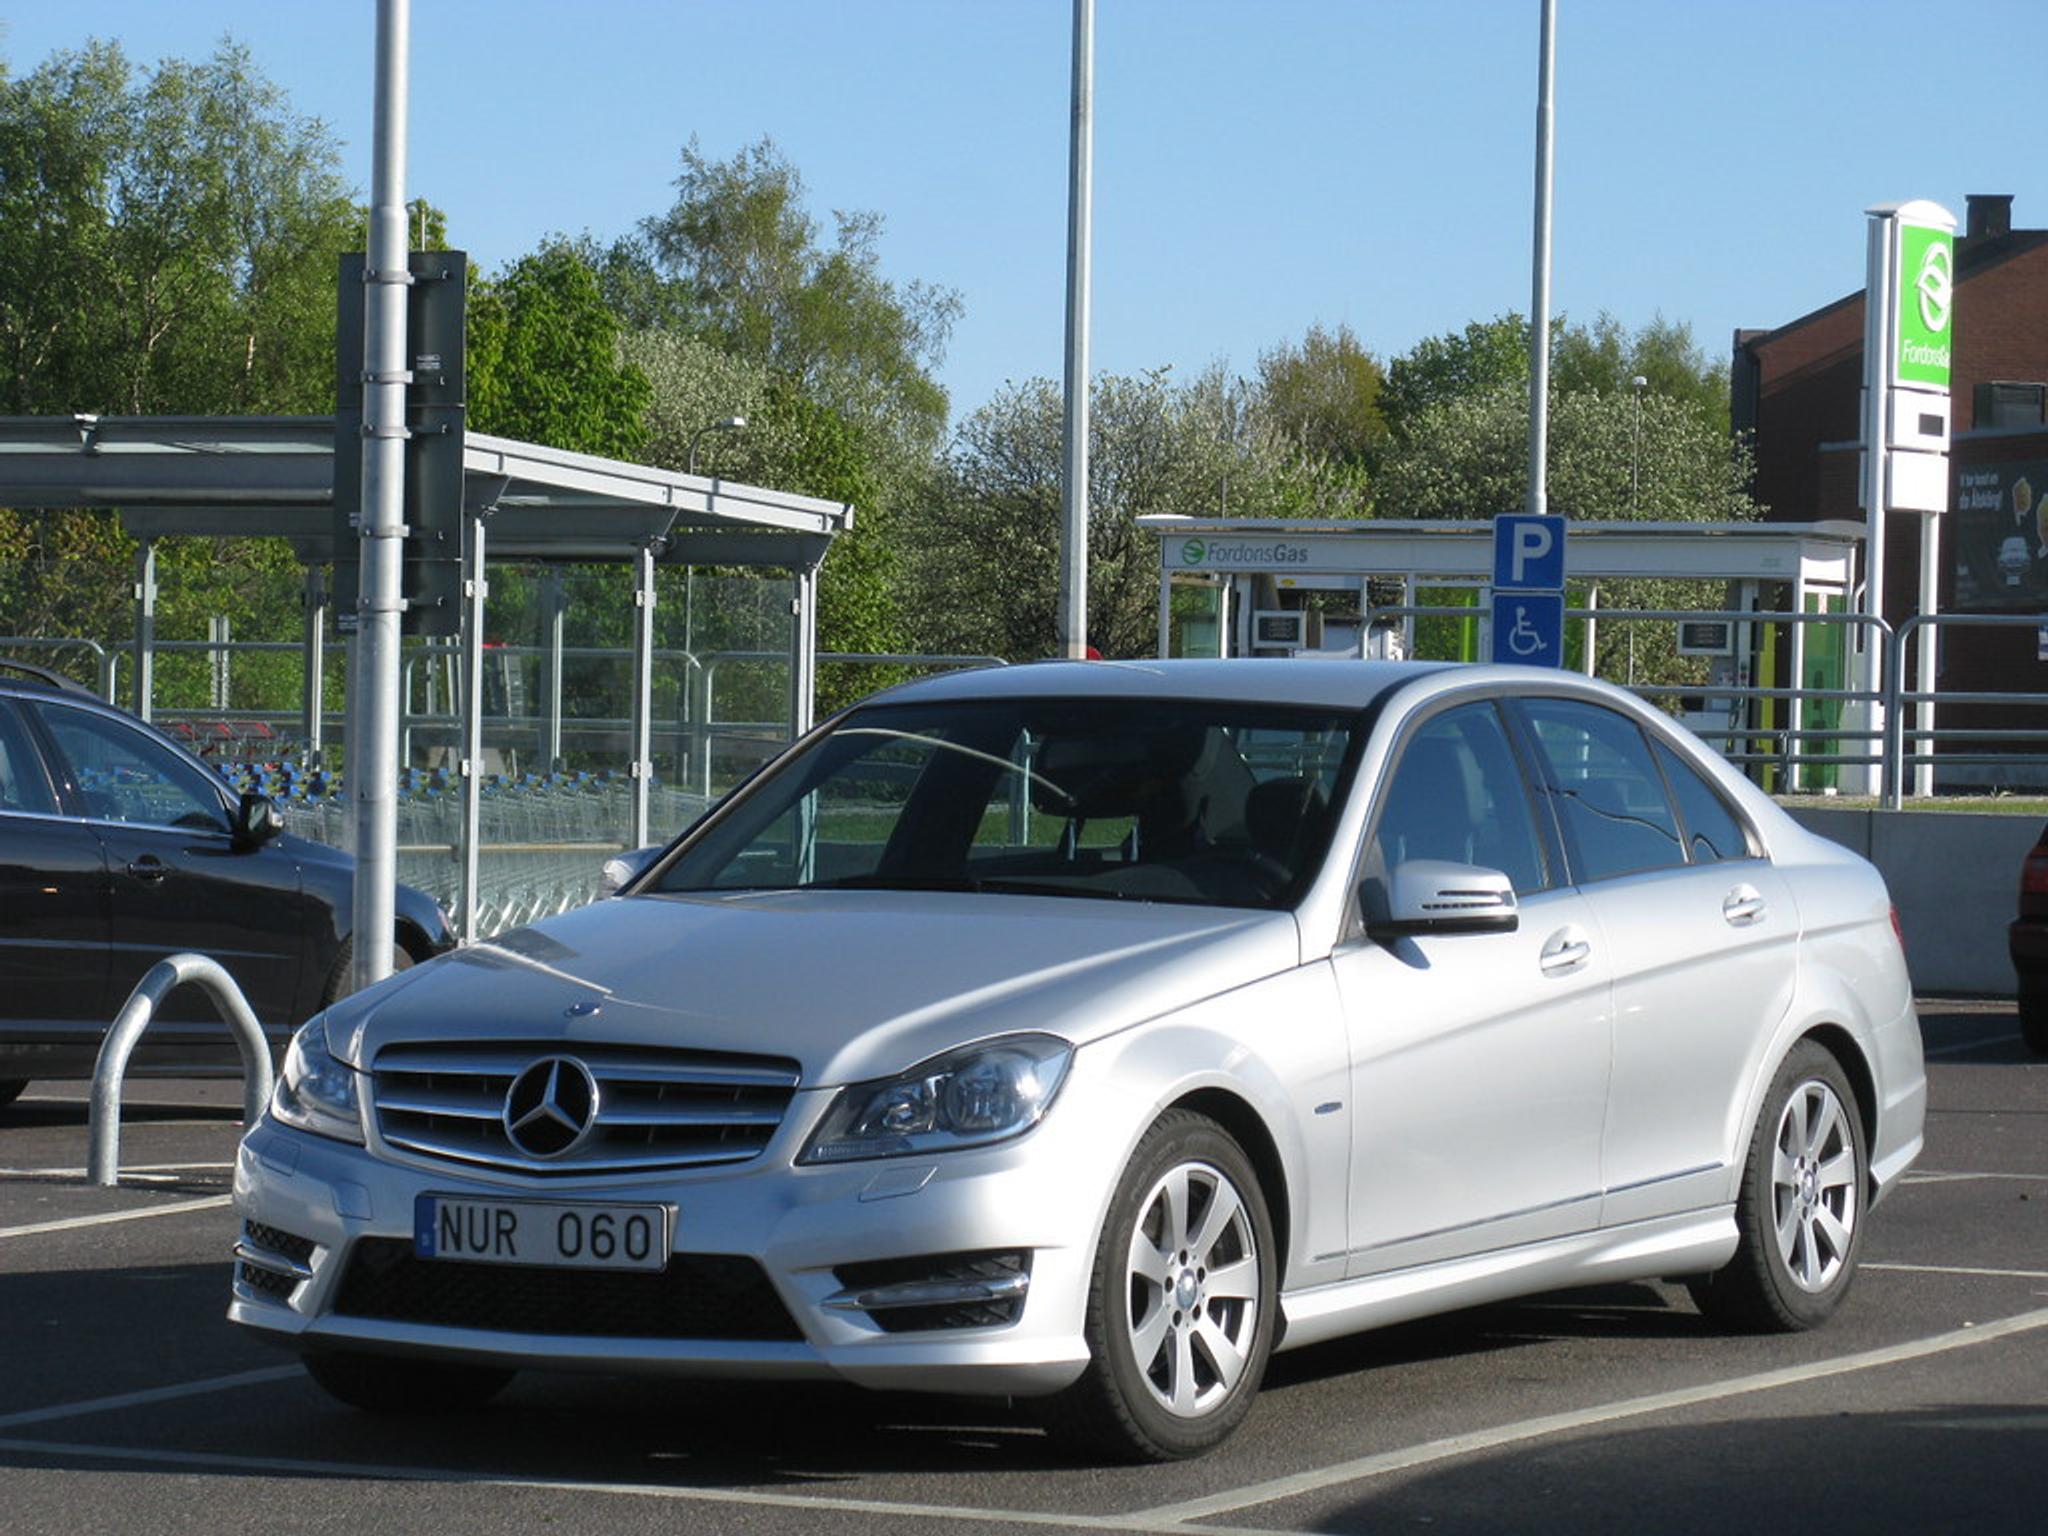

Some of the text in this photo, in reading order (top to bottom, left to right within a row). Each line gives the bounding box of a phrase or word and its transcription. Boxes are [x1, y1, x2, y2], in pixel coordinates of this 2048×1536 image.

[1207, 542, 1309, 562] FordonsGas
[1511, 523, 1552, 582] P
[440, 1205, 650, 1261] NUR 060
